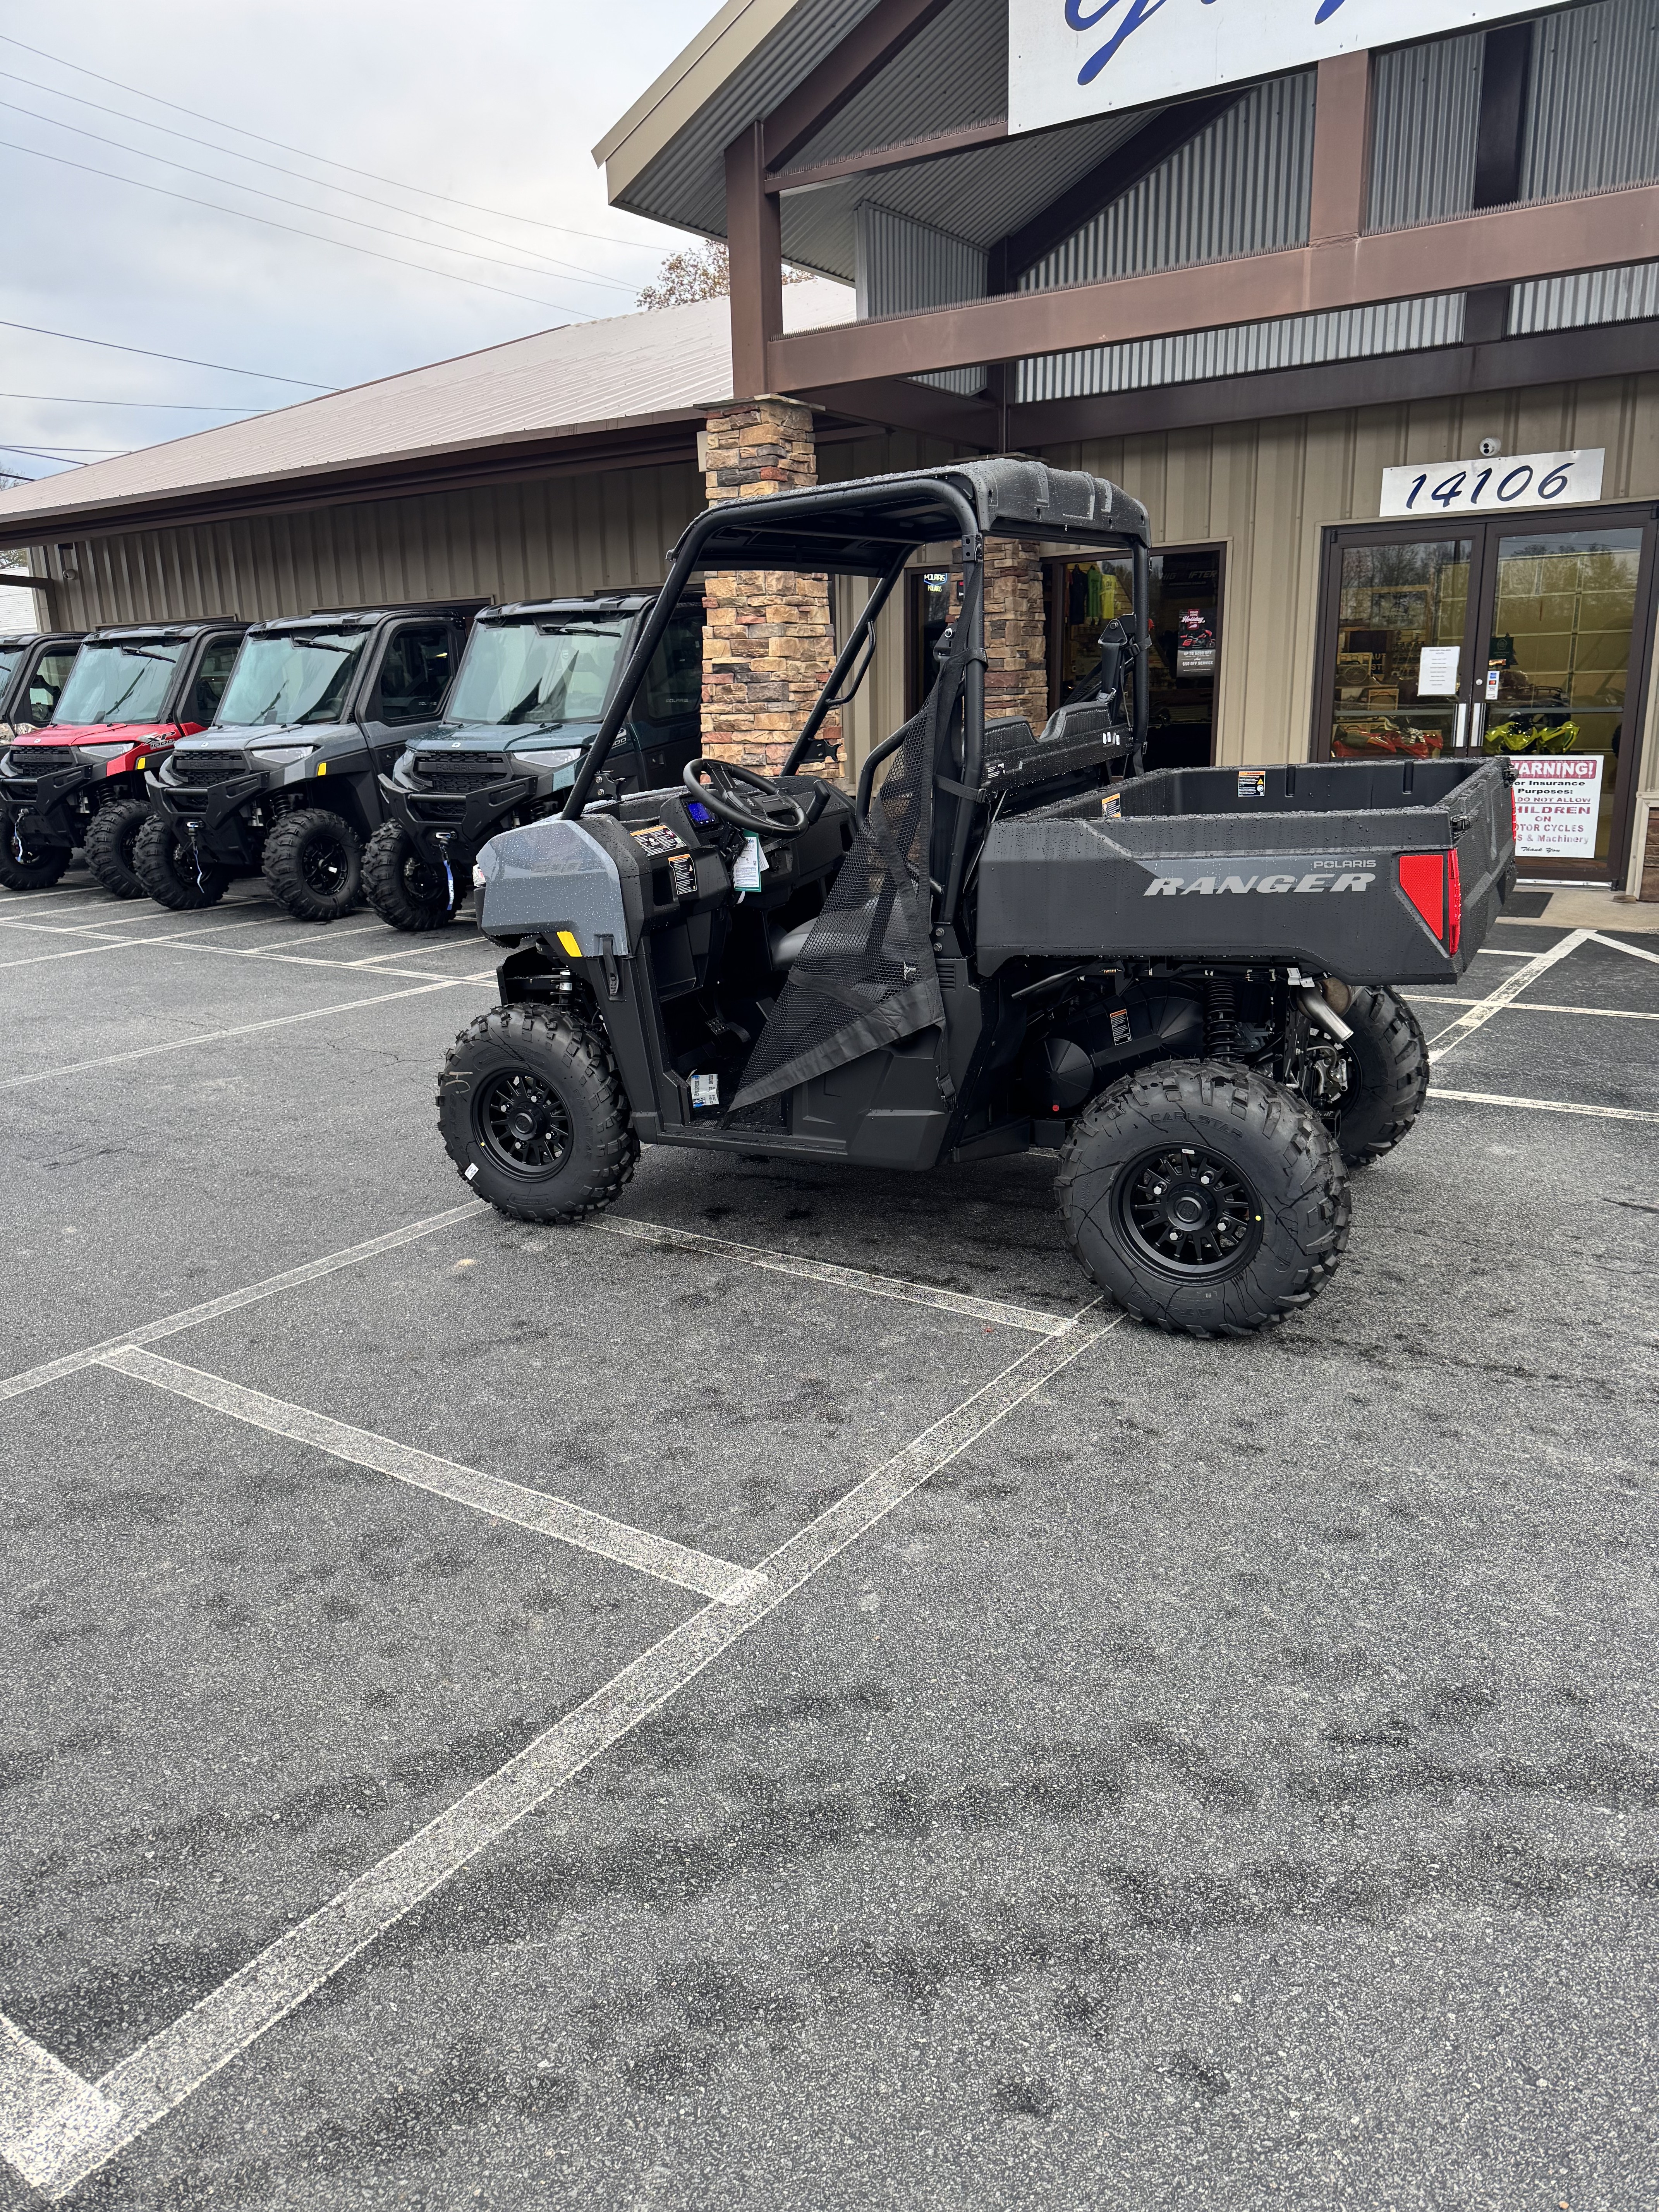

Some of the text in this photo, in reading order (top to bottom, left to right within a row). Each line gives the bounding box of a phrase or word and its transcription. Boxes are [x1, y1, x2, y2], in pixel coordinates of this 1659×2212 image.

[1406, 463, 1575, 509] 14106
[143, 731, 177, 745] XP
[151, 739, 174, 749] 1000
[436, 763, 477, 772] POLARIS
[1544, 824, 1584, 832] CYCLES
[1537, 835, 1589, 845] Machinery
[1314, 860, 1376, 869] POLARIS
[1143, 872, 1376, 896] RANGER
[1151, 1111, 1243, 1139] CARLSTAR
